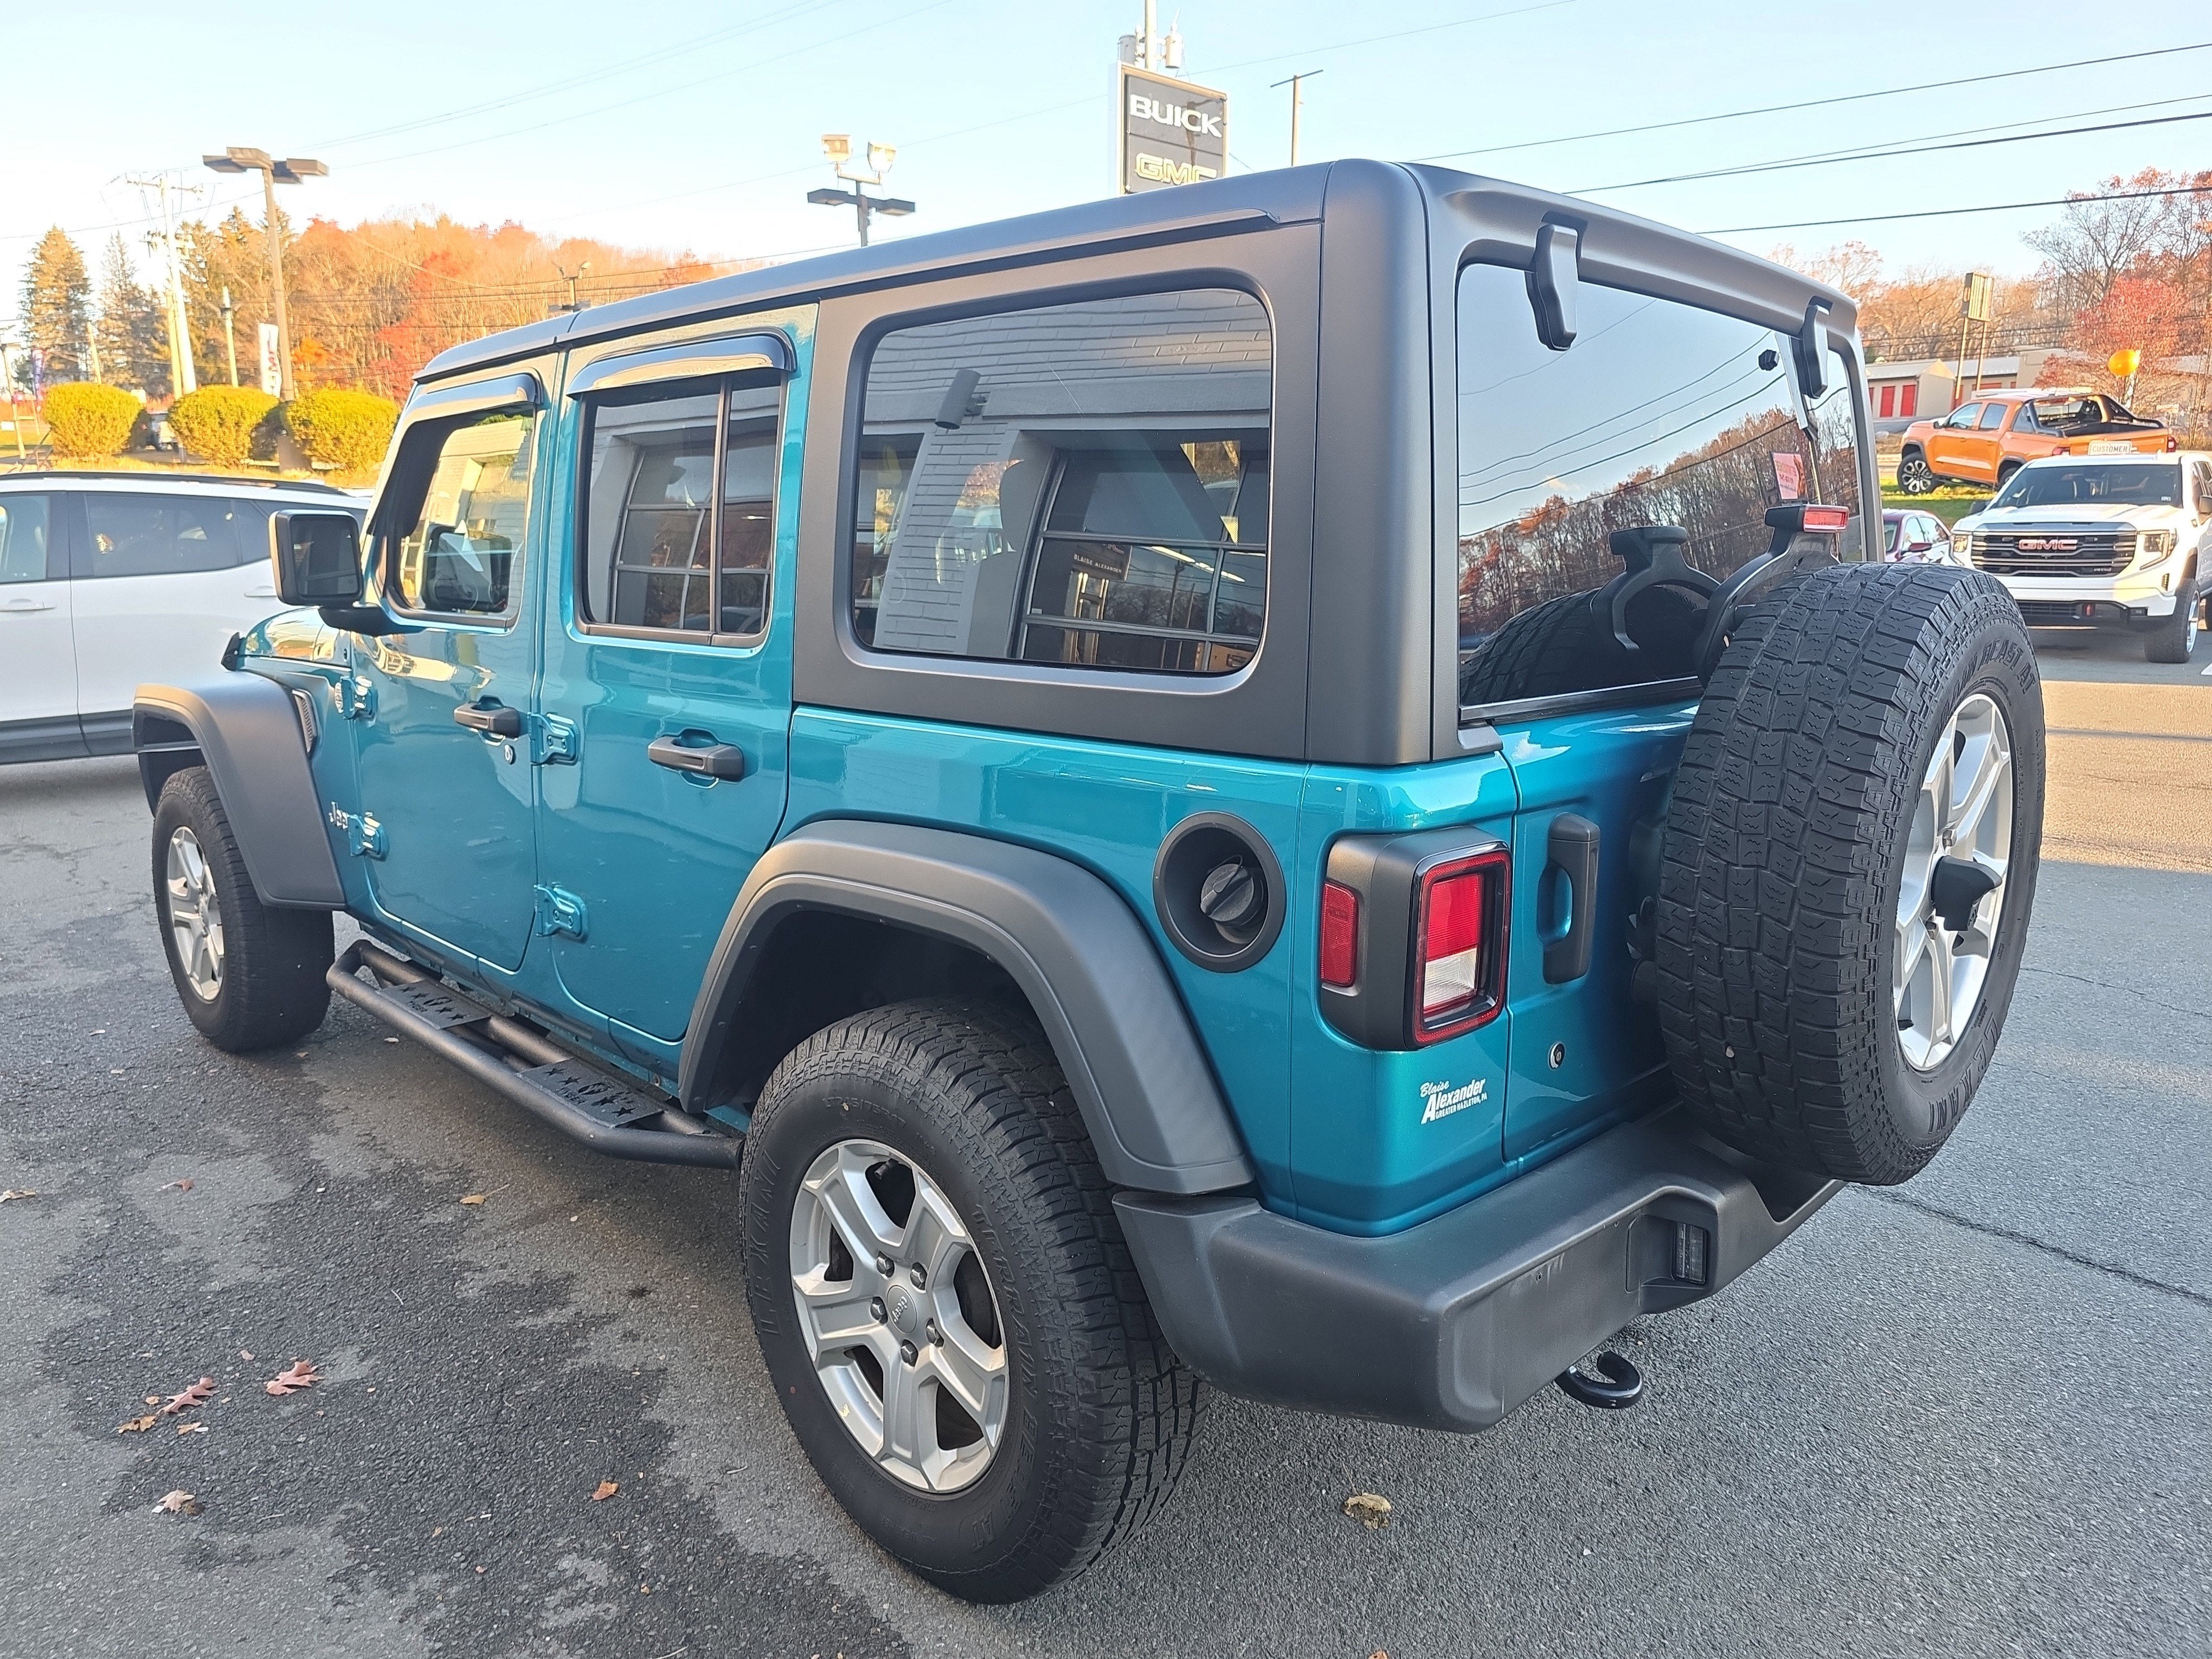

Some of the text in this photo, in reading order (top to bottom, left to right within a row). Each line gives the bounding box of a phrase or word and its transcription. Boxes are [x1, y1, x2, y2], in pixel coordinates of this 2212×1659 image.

[1130, 94, 1222, 138] BUICK
[2018, 539, 2078, 550] GMC
[1073, 554, 1122, 574] BLAISE ALEXANDER
[1420, 1080, 1450, 1098] Blaise
[1420, 1078, 1486, 1124] Alexander
[1436, 1092, 1488, 1119] GREATER HAZLETON, PA
[892, 1296, 908, 1323] Jeep
[972, 1203, 1038, 1399] TERRAIN
